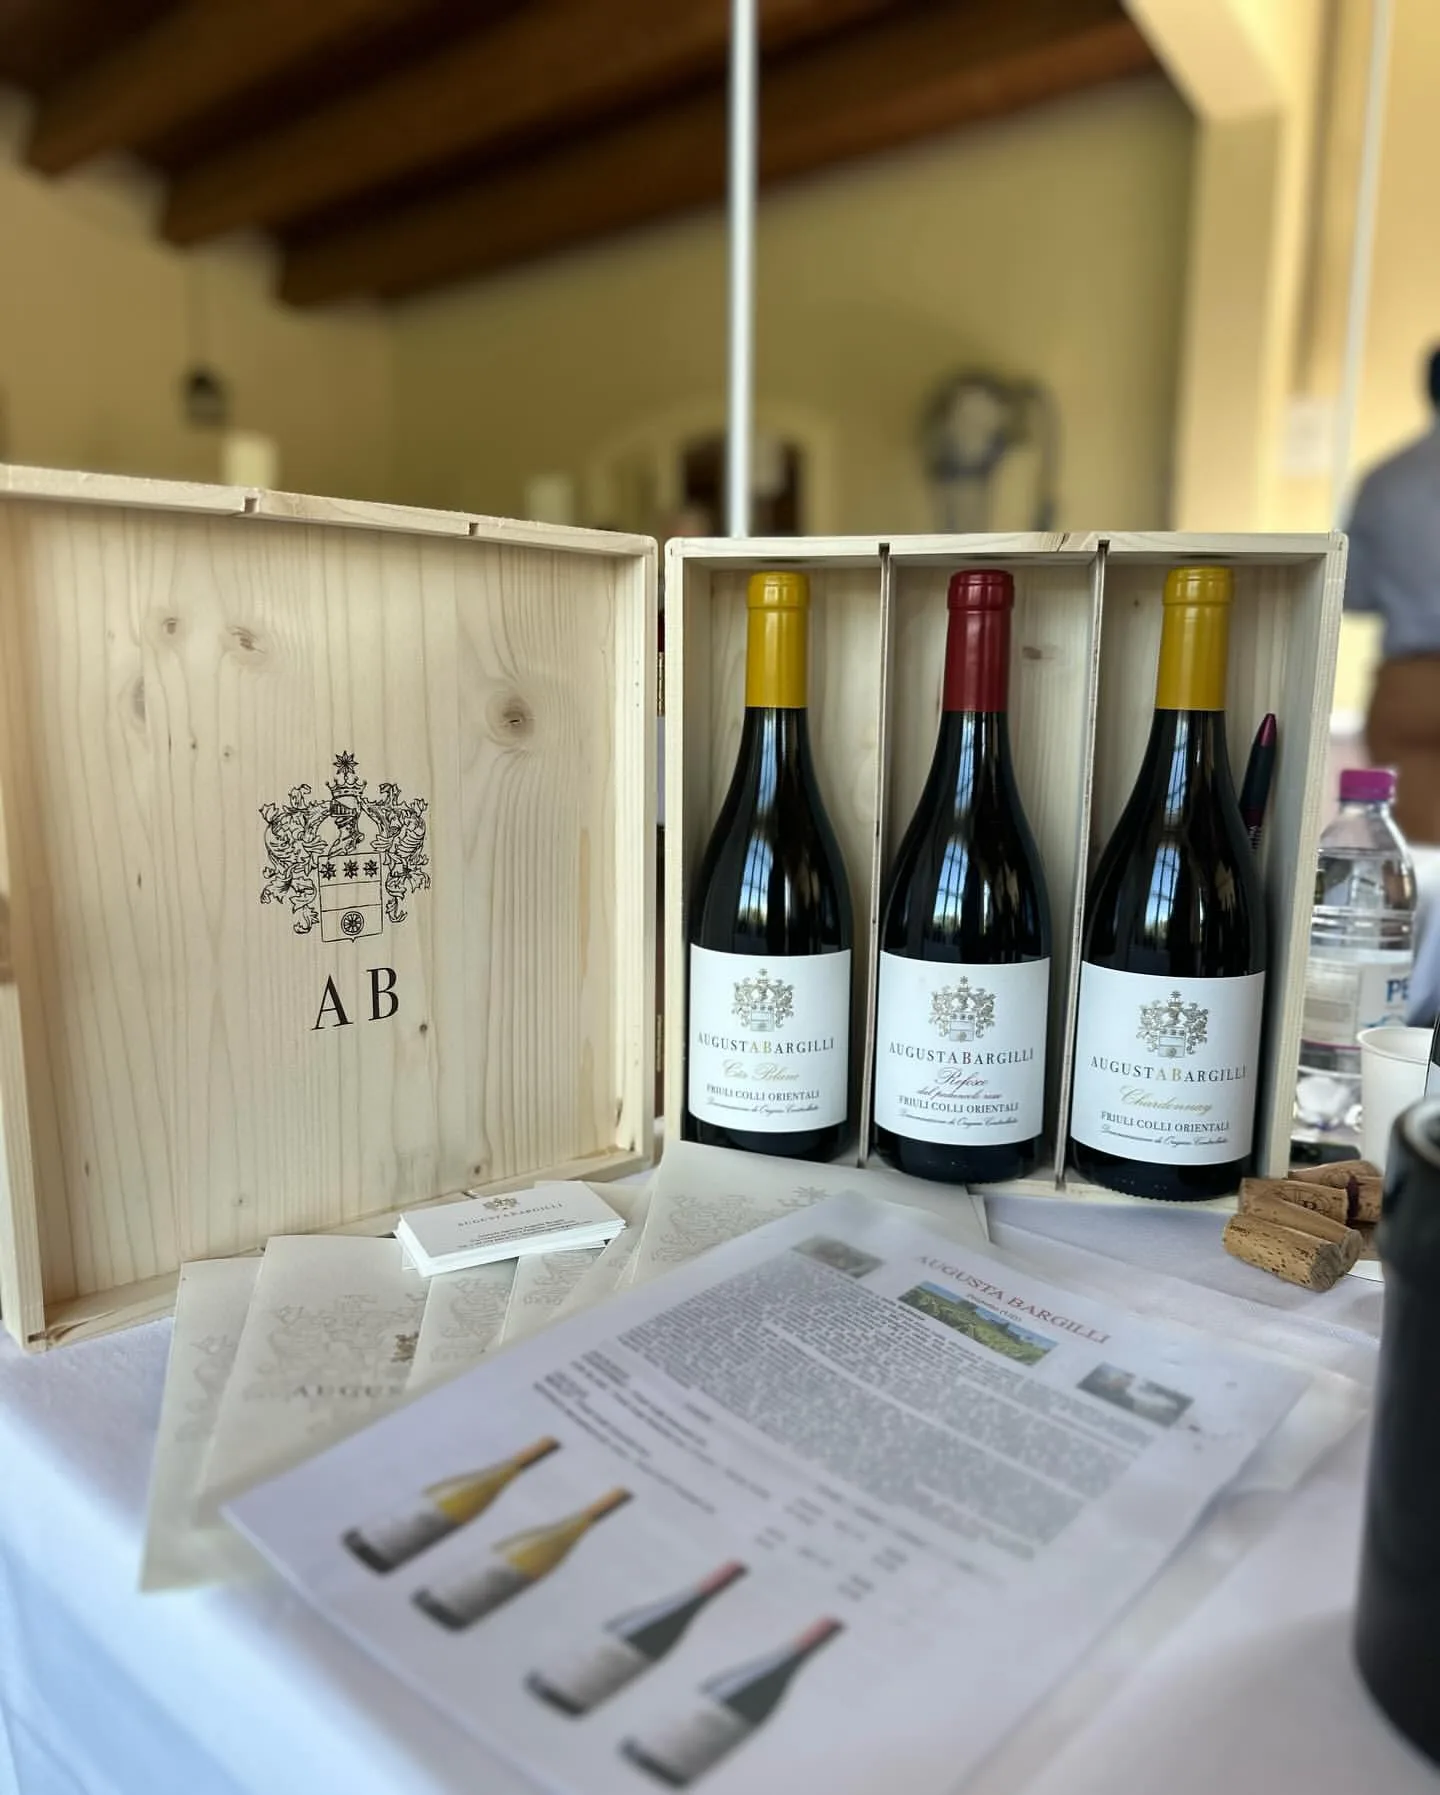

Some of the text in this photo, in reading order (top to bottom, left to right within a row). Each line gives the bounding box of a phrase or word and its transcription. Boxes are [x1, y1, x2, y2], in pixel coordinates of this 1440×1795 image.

[706, 1083, 820, 1101] FRIULI COLLI ORIENTALI
[1119, 1085, 1212, 1116] Chardonnay
[898, 1095, 1019, 1113] FRIULI COLLI ORIENTALI
[1101, 1111, 1230, 1133] FRIULI COLLI ORIENTALI
[917, 1255, 1004, 1301] AUGUSTA
[1007, 1296, 1112, 1344] BARGILLI
